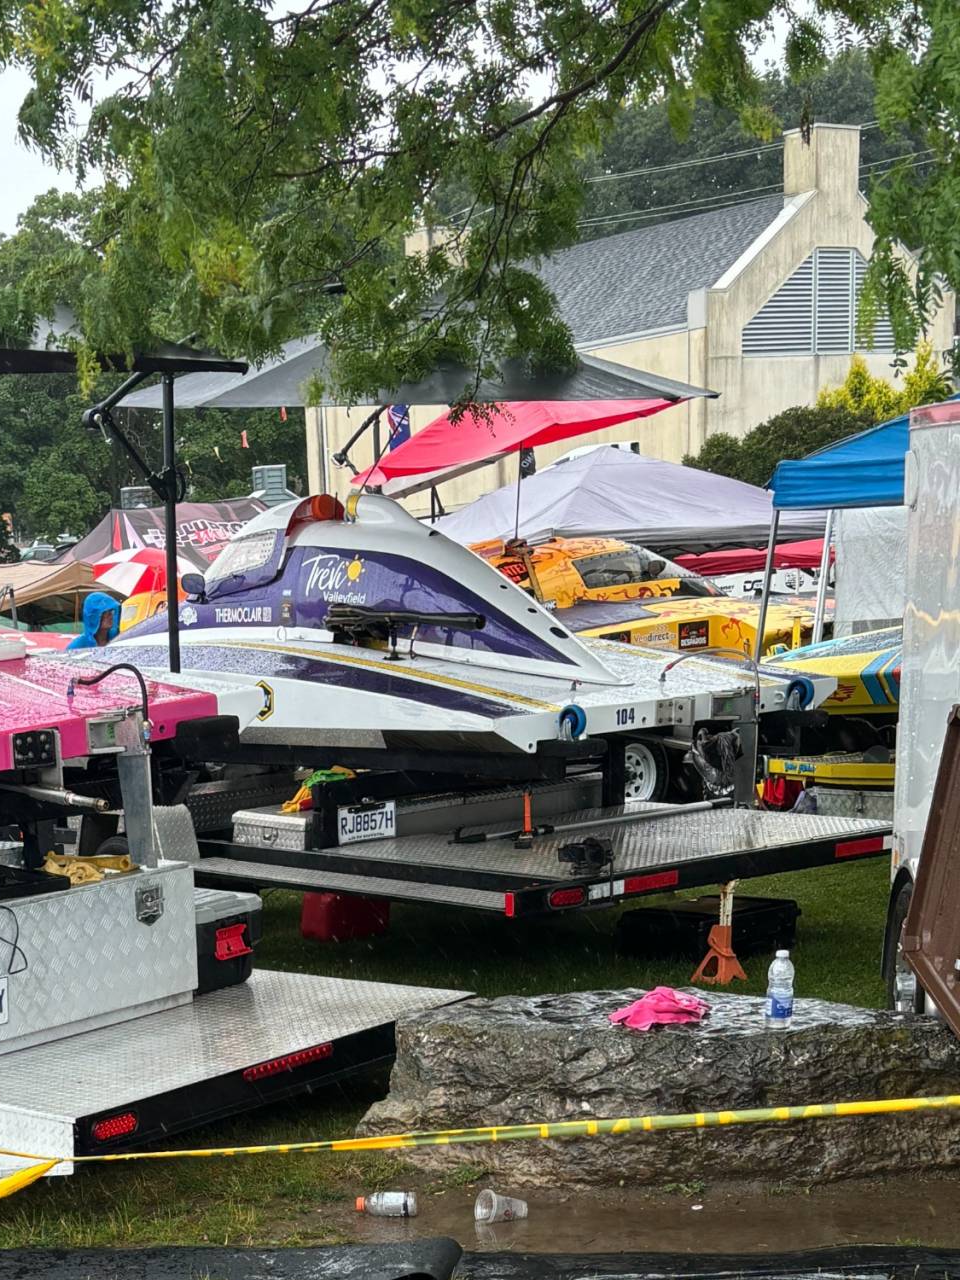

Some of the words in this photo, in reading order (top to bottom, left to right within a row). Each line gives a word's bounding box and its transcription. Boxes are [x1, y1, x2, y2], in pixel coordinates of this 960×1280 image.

[301, 554, 348, 597] Trévi
[323, 591, 367, 605] Valleyfield
[214, 607, 262, 623] THERMOCLAIR
[616, 707, 635, 726] 104
[340, 809, 394, 837] RJ8857H
